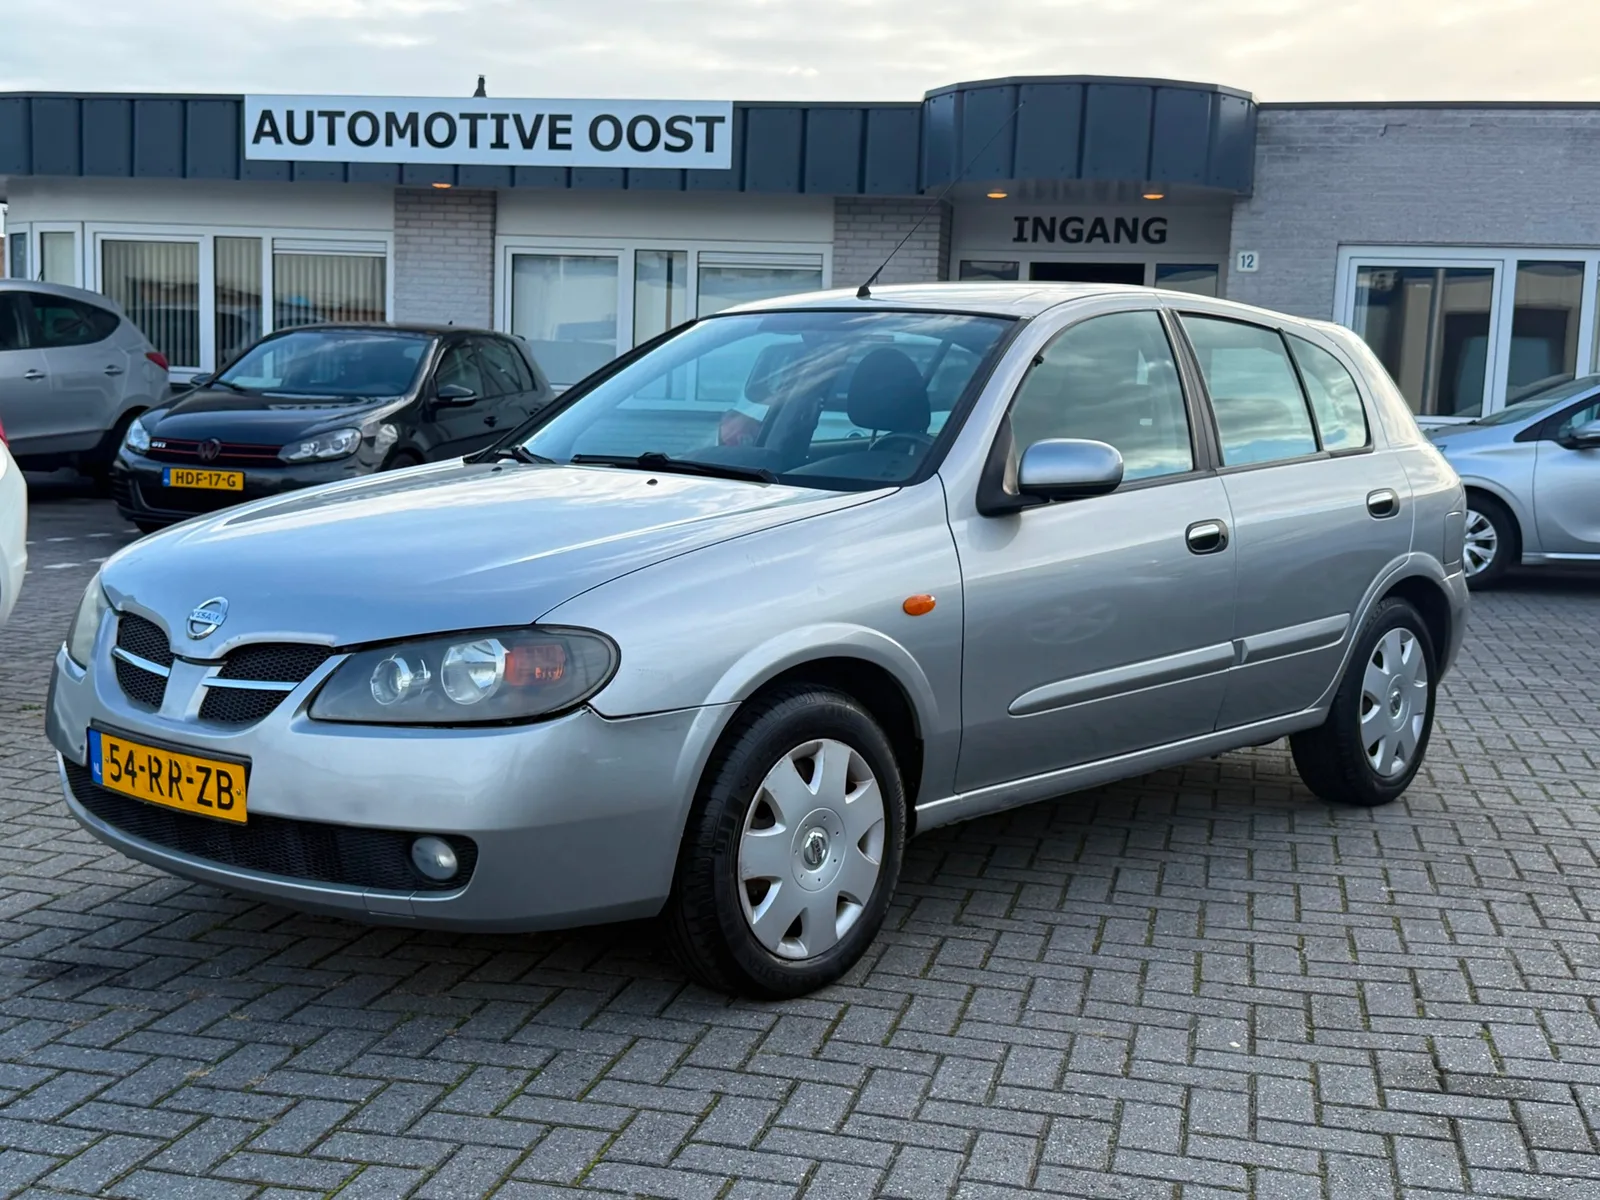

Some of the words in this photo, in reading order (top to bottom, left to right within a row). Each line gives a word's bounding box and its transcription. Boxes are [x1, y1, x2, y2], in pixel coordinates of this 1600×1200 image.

[251, 108, 573, 151] AUTOMOTIVE
[588, 113, 726, 154] OOST
[1012, 216, 1168, 245] INGANG
[1241, 254, 1254, 268] 12
[175, 471, 236, 488] HDF-17-G
[109, 743, 235, 811] 54-RR-ZB
